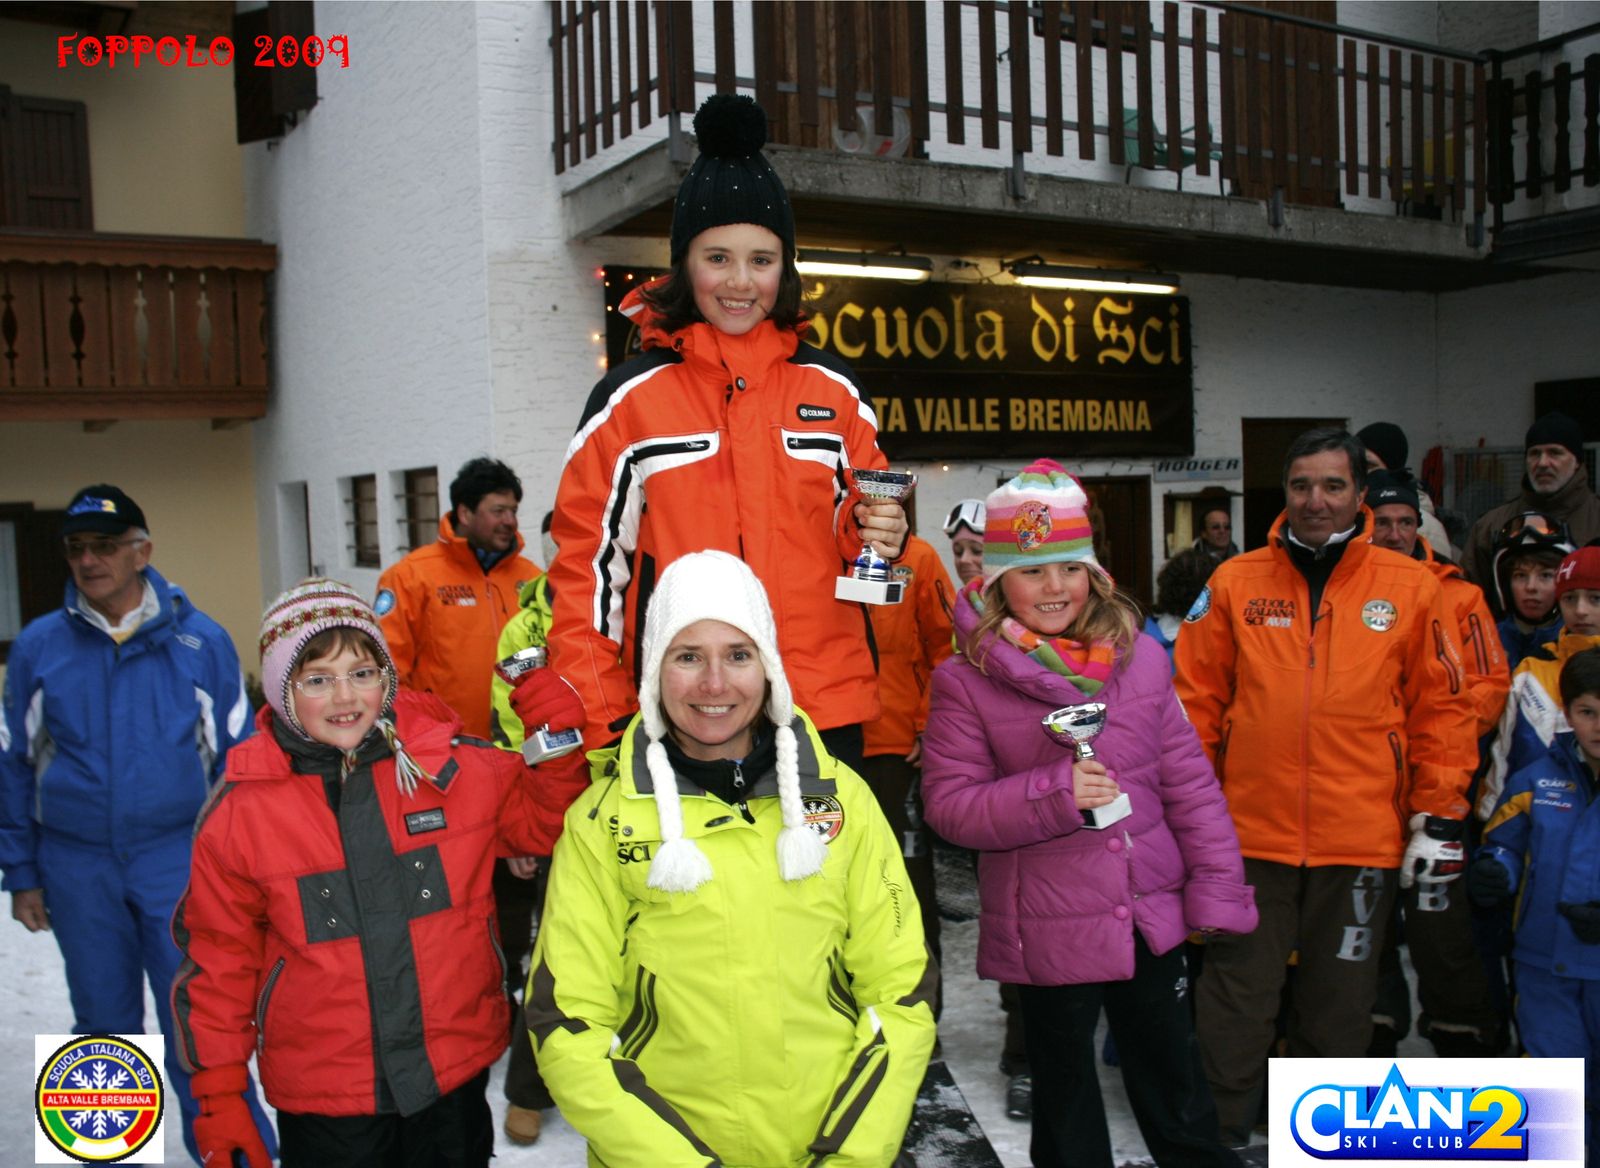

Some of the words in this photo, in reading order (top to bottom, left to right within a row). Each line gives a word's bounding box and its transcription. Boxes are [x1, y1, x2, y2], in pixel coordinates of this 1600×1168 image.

[1031, 294, 1080, 363] di
[1092, 298, 1183, 366] Sci
[807, 409, 831, 417] COLMAR
[914, 398, 1000, 432] VALLE
[1010, 398, 1152, 432] BREMBANA
[1248, 598, 1296, 609] SCUOLA
[1243, 607, 1296, 618] ITALIANA
[1244, 616, 1265, 626] SCI
[617, 845, 652, 865] SCI
